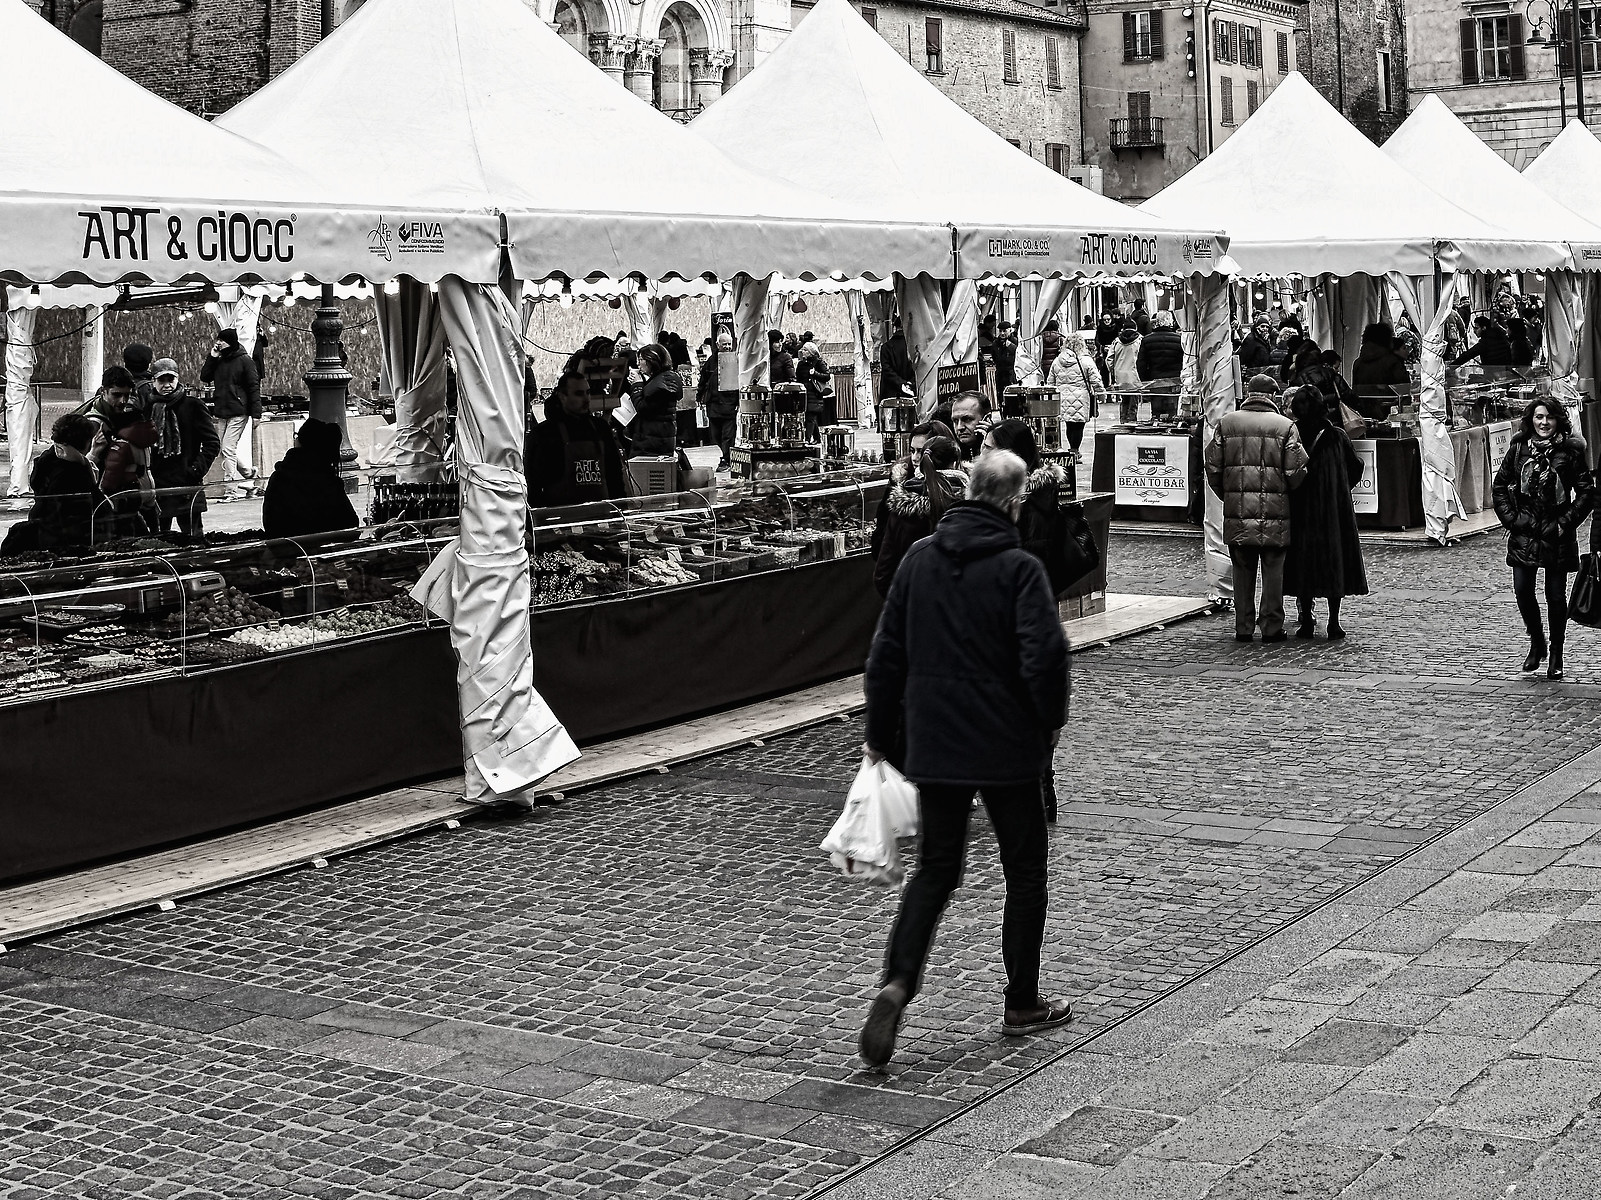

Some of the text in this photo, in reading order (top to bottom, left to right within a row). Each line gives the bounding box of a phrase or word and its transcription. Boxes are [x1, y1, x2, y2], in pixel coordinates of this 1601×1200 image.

[77, 206, 160, 260] ART
[167, 215, 188, 260] &
[411, 222, 444, 238] FIVA
[1080, 233, 1108, 265] ART
[1111, 237, 1119, 265] &
[938, 364, 978, 381] CIOCCOLATA
[938, 381, 960, 395] CALDA
[574, 459, 595, 473] ART
[1118, 477, 1185, 488] BEAN TO BAR
